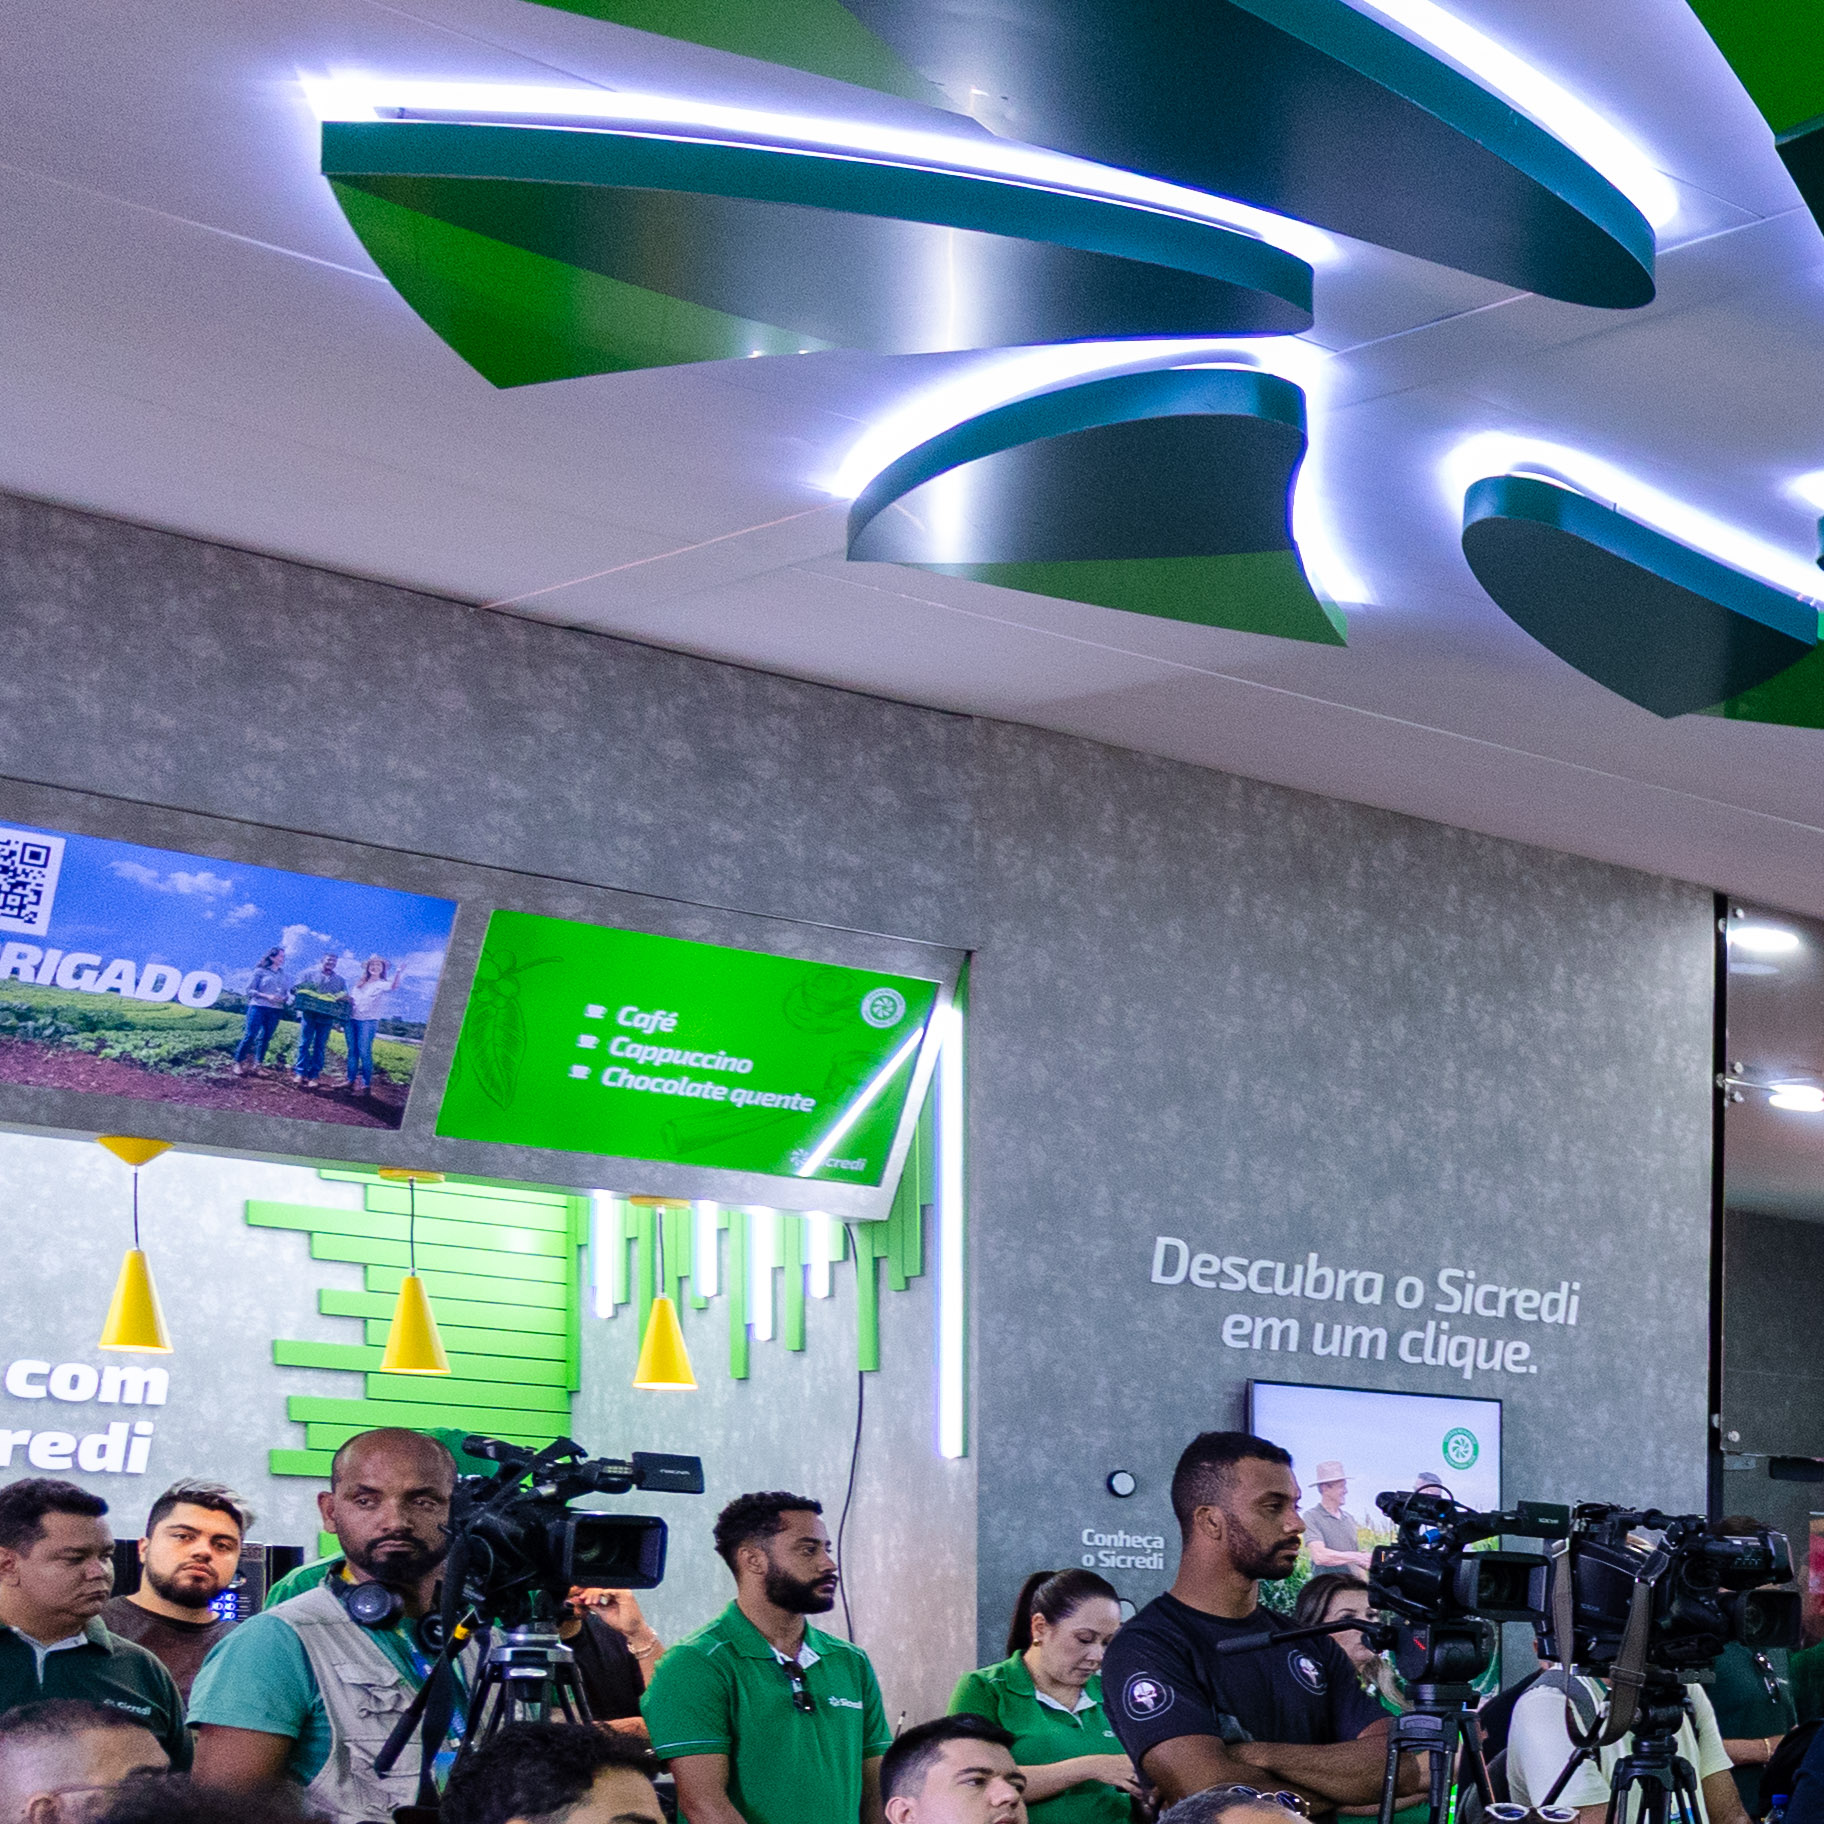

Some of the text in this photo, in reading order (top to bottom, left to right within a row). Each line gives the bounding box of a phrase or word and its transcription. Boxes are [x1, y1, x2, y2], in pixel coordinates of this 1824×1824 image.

[616, 1005, 679, 1034] Café
[608, 1036, 754, 1075] Cappuccino
[600, 1066, 817, 1113] Chocolate quente
[818, 1154, 868, 1172] credi
[1150, 1236, 1581, 1326] Descubra o Sicredi
[1221, 1312, 1538, 1379] em um clique.
[5, 1359, 170, 1405] com
[1081, 1528, 1165, 1554] Conheça
[1081, 1550, 1164, 1570] o Sicredi
